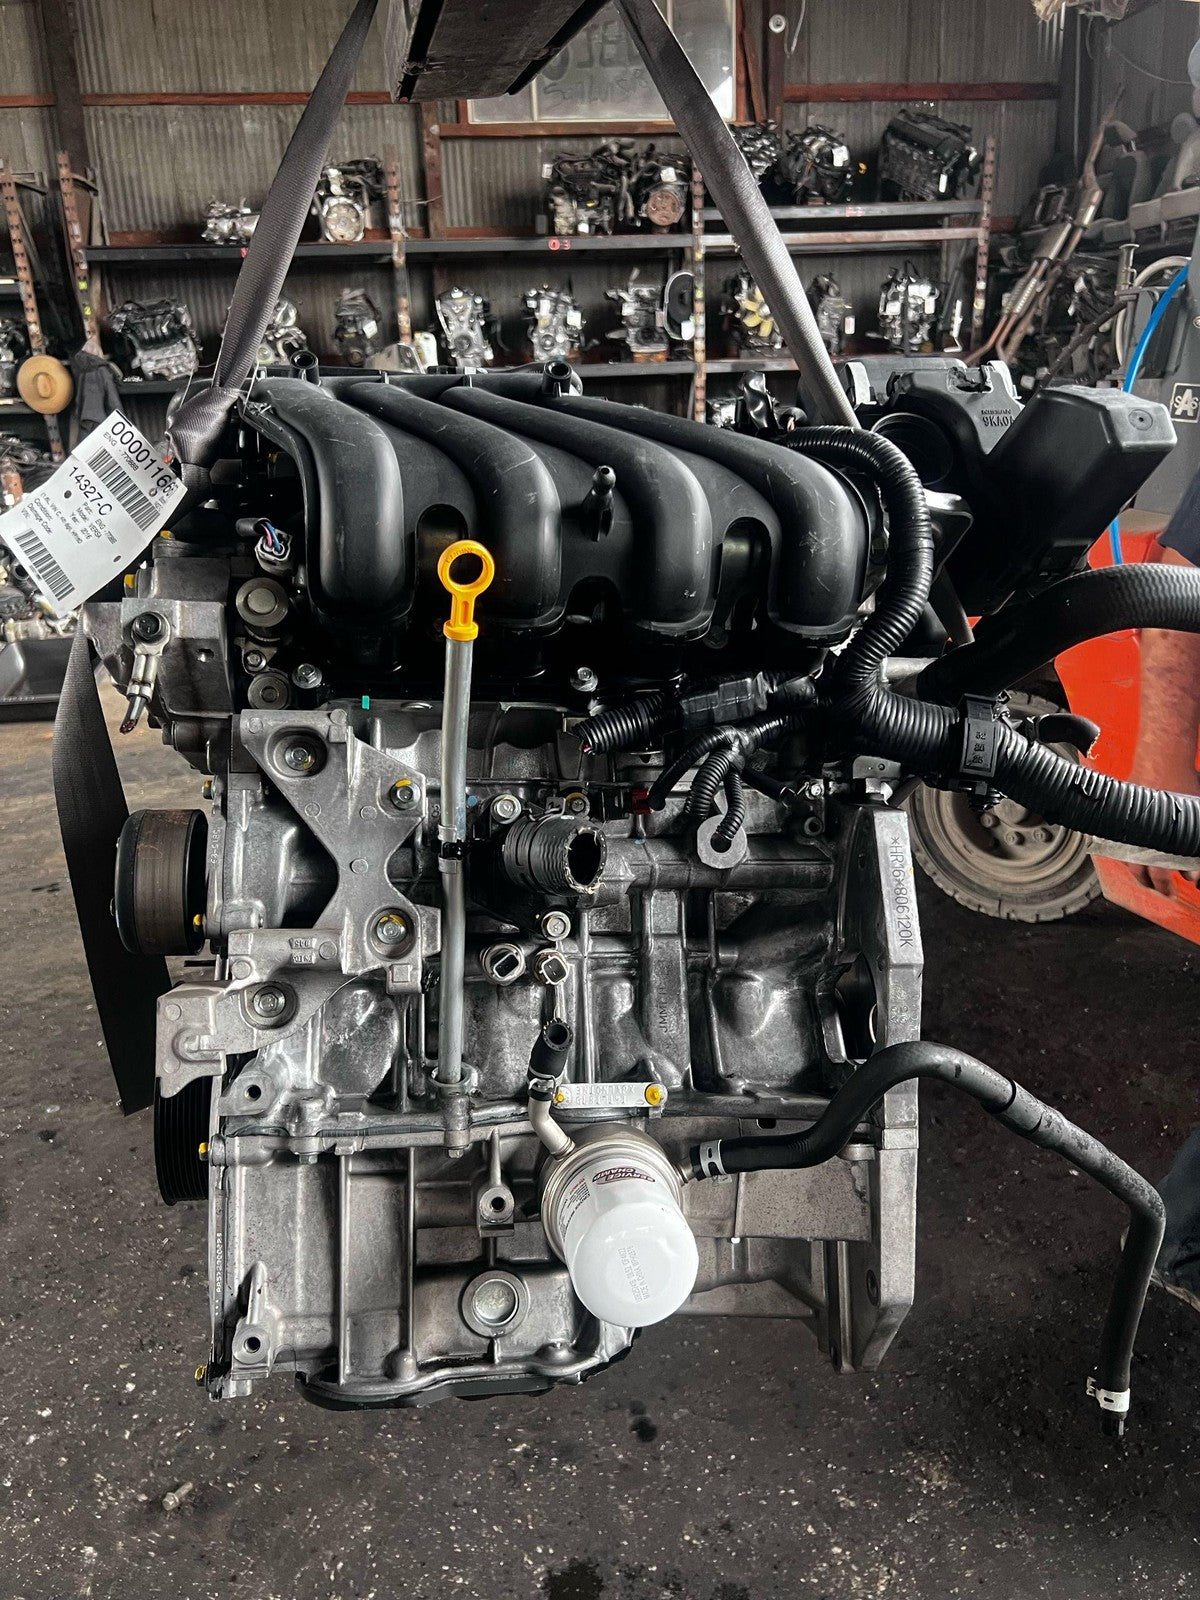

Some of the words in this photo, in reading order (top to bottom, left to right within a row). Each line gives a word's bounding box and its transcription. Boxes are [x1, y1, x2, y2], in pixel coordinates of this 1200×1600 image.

[103, 431, 118, 447] ENG
[69, 466, 113, 516] 14327-C
[88, 523, 102, 539] VERSA
